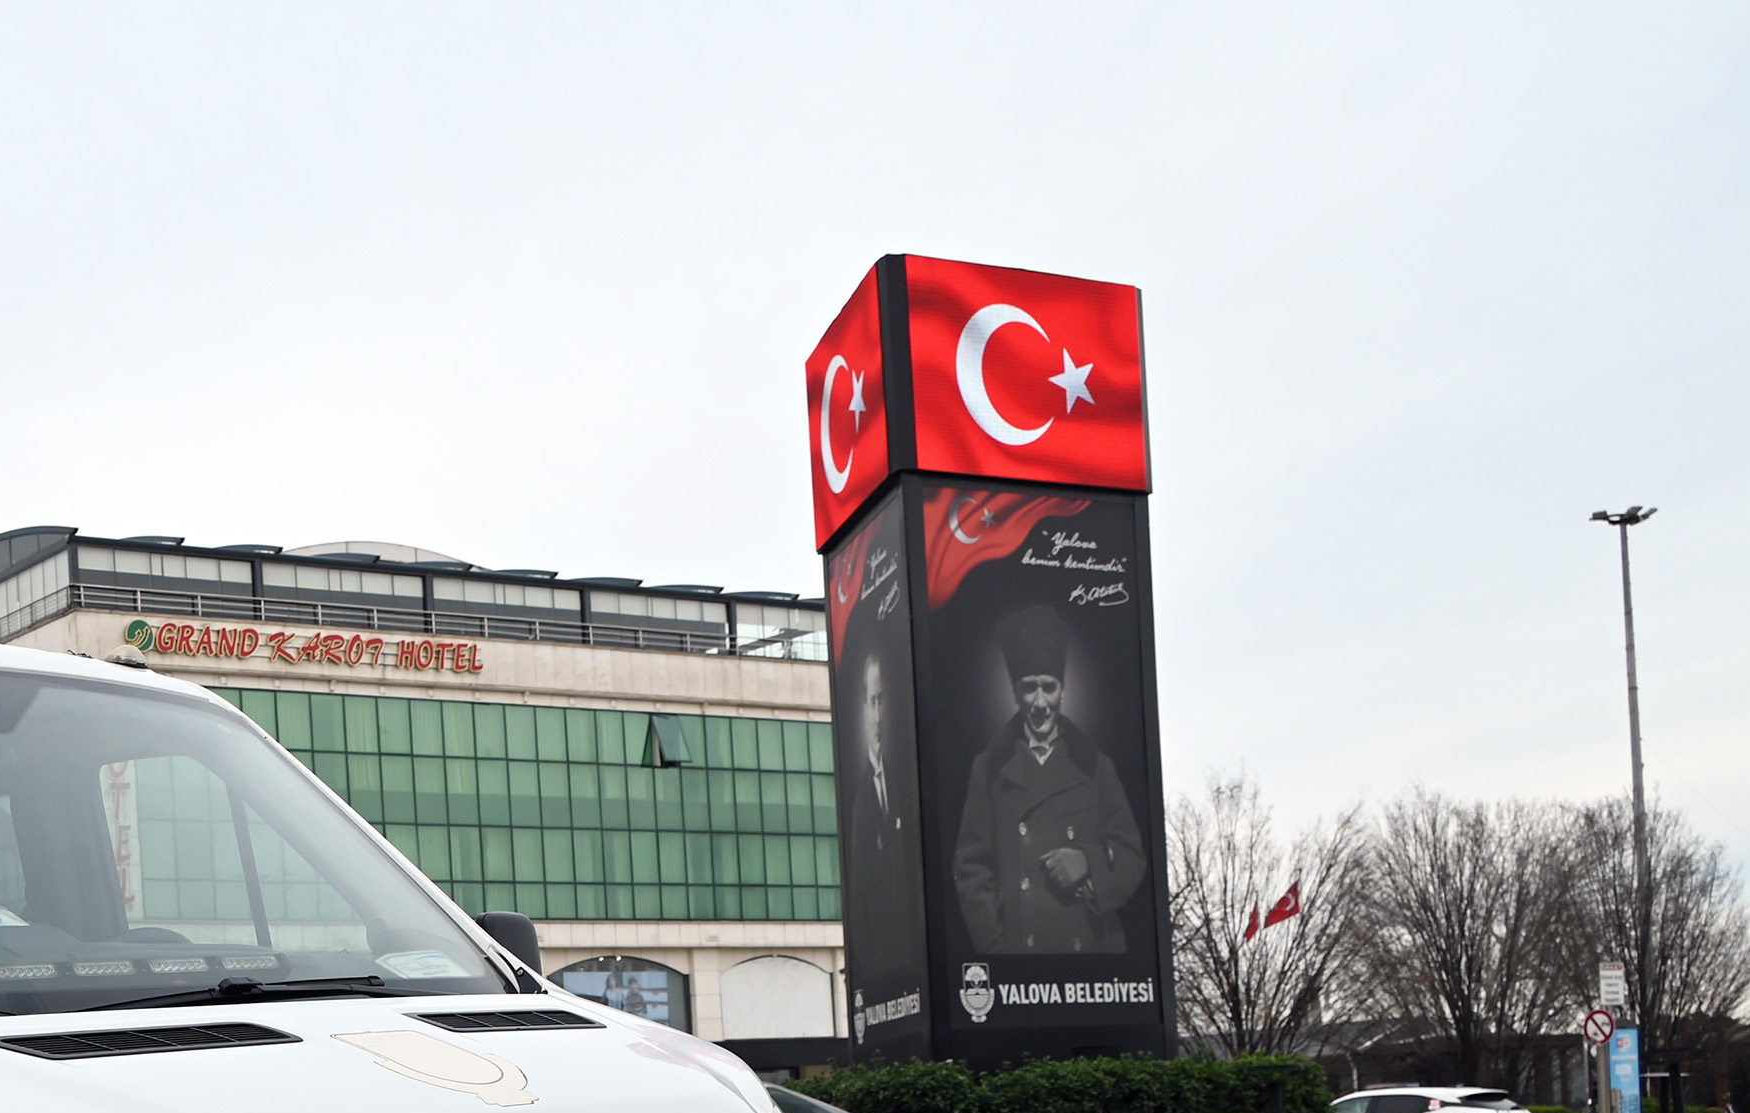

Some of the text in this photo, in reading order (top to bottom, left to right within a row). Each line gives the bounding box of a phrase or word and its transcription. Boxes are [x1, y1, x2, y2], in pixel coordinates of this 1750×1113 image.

[156, 622, 485, 673] GRAND KAROT HOTEL
[999, 977, 1154, 1005] YALOVA BELEDİYESİ
